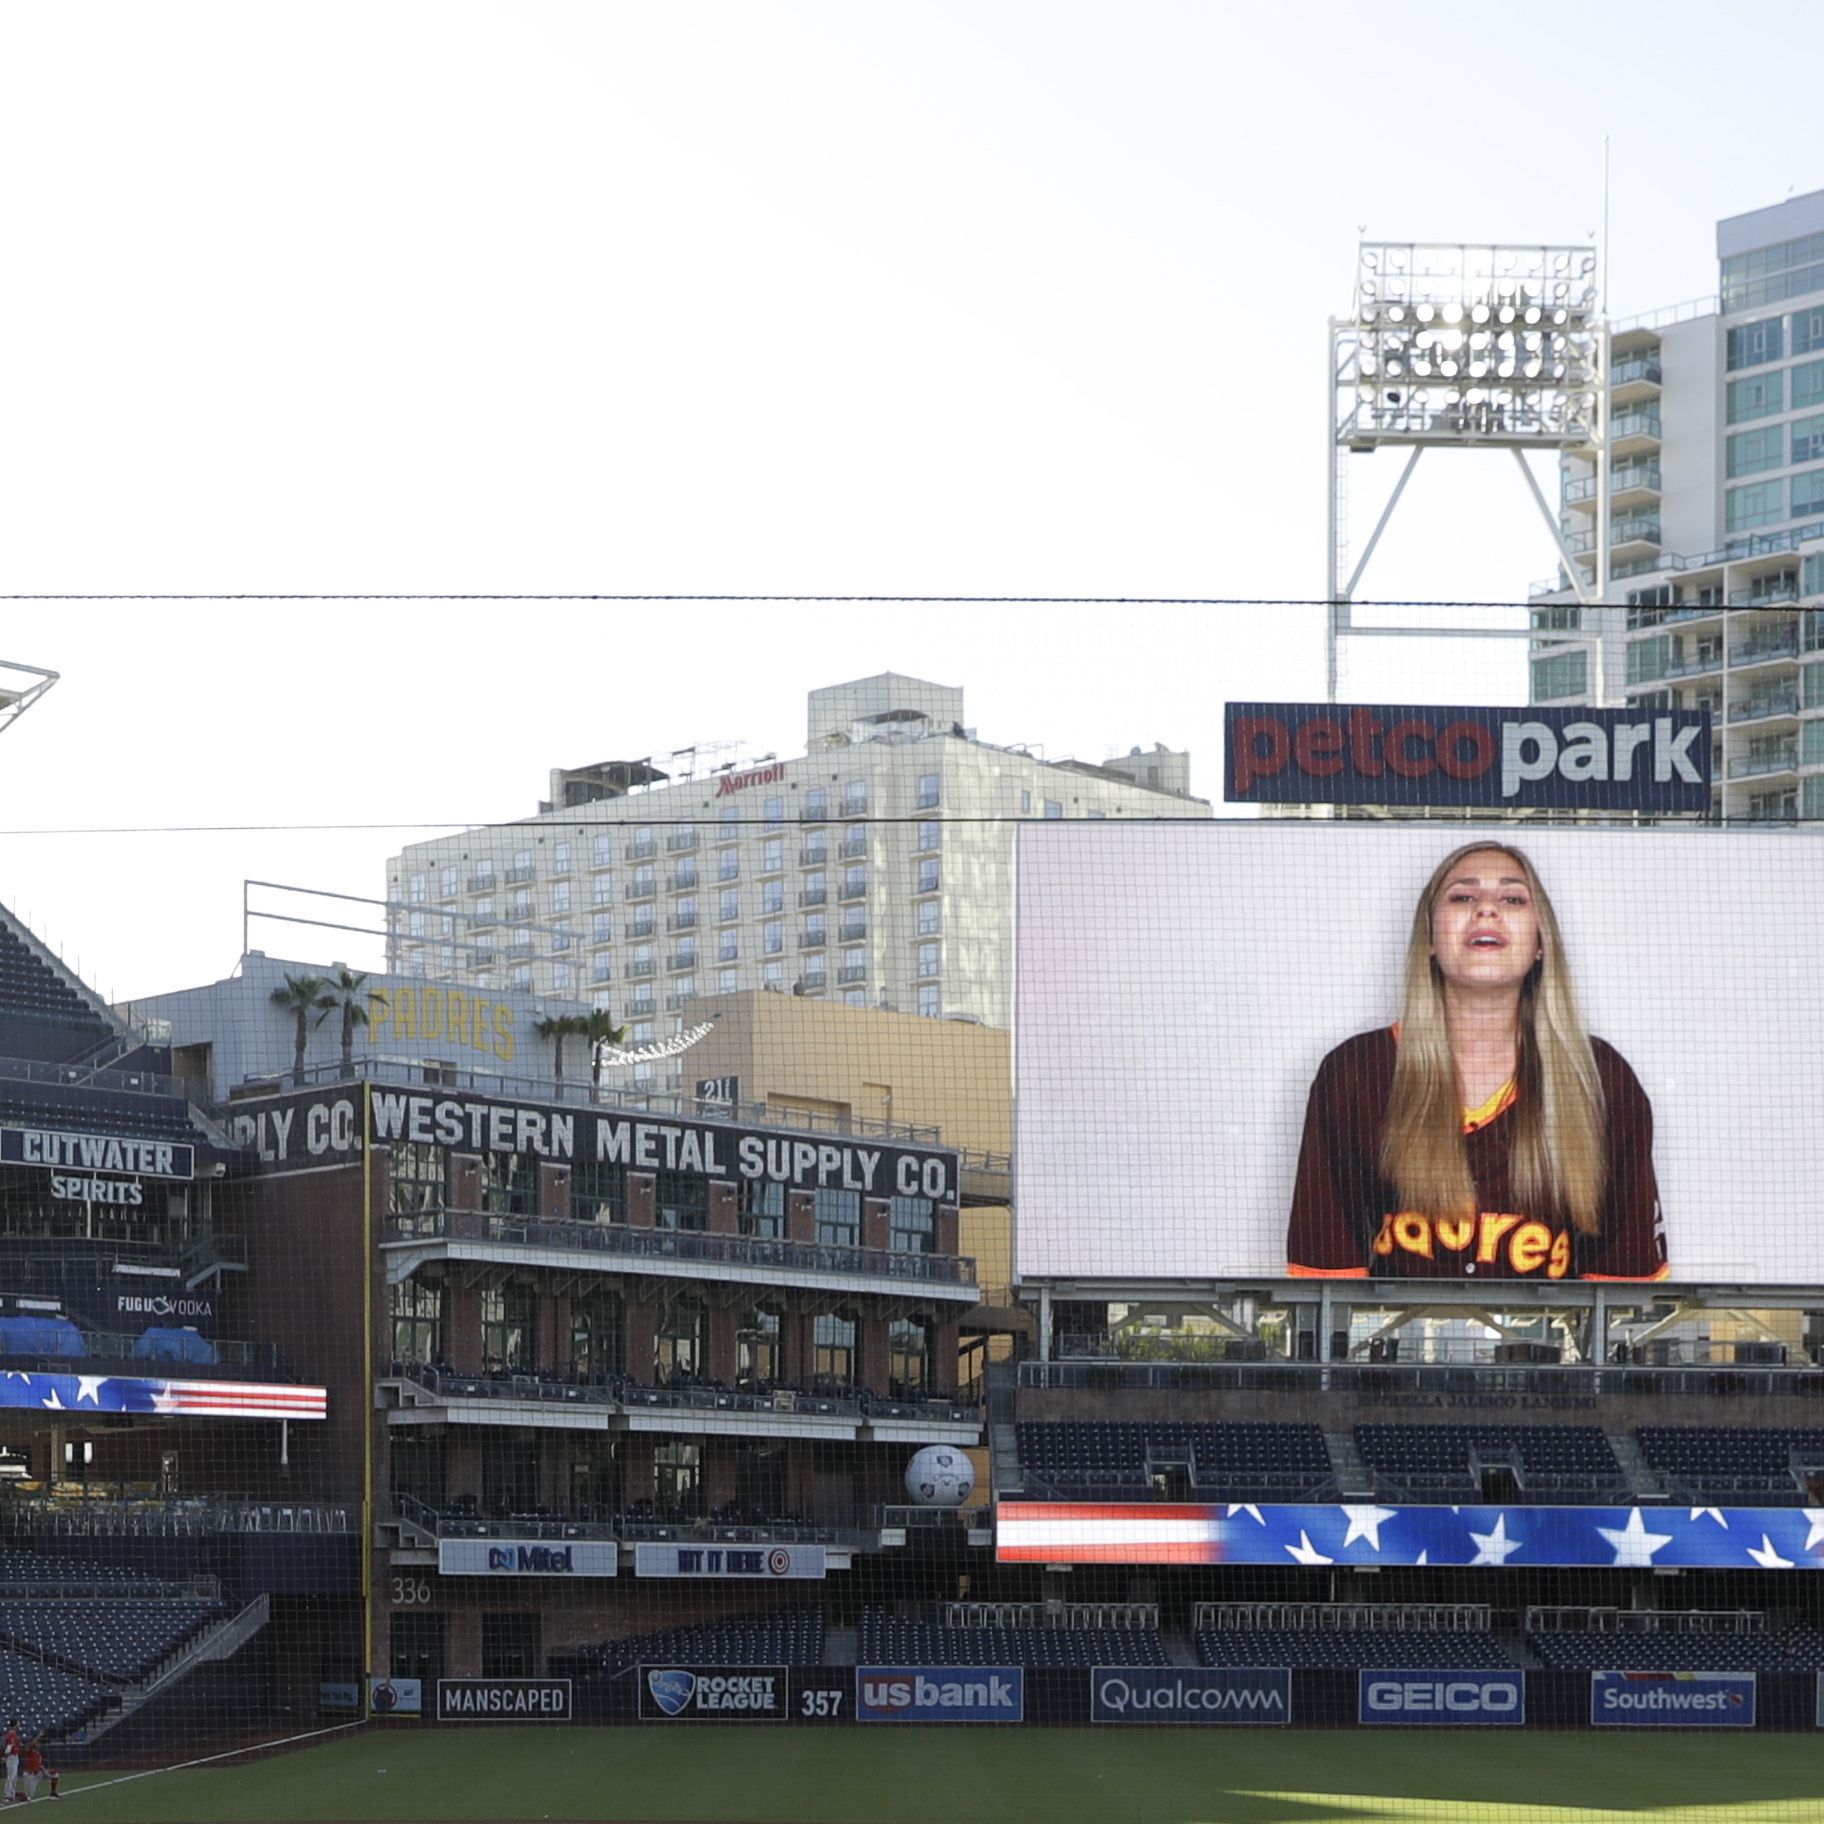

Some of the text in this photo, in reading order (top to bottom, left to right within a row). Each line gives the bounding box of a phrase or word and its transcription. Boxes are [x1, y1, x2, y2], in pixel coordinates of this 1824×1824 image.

[1502, 717, 1704, 798] park
[368, 985, 515, 1061] PADRES
[307, 1099, 363, 1156] CO.
[23, 1132, 174, 1175] CUTWATER
[371, 1091, 955, 1200] WESTERN METAL SUPPLY CO.
[51, 1175, 143, 1205] SPIRITS
[117, 1296, 213, 1316] FUGU VODKA
[517, 1545, 574, 1573] Mitel
[391, 1577, 432, 1605] 336
[697, 1675, 775, 1693] ROCKET
[1100, 1678, 1284, 1713] Qualcomm
[1367, 1681, 1519, 1712] GEICO
[1603, 1687, 1727, 1710] Southwest
[445, 1689, 564, 1712] MANSCAPED
[696, 1693, 776, 1710] LEAGUE
[801, 1690, 843, 1717] 357
